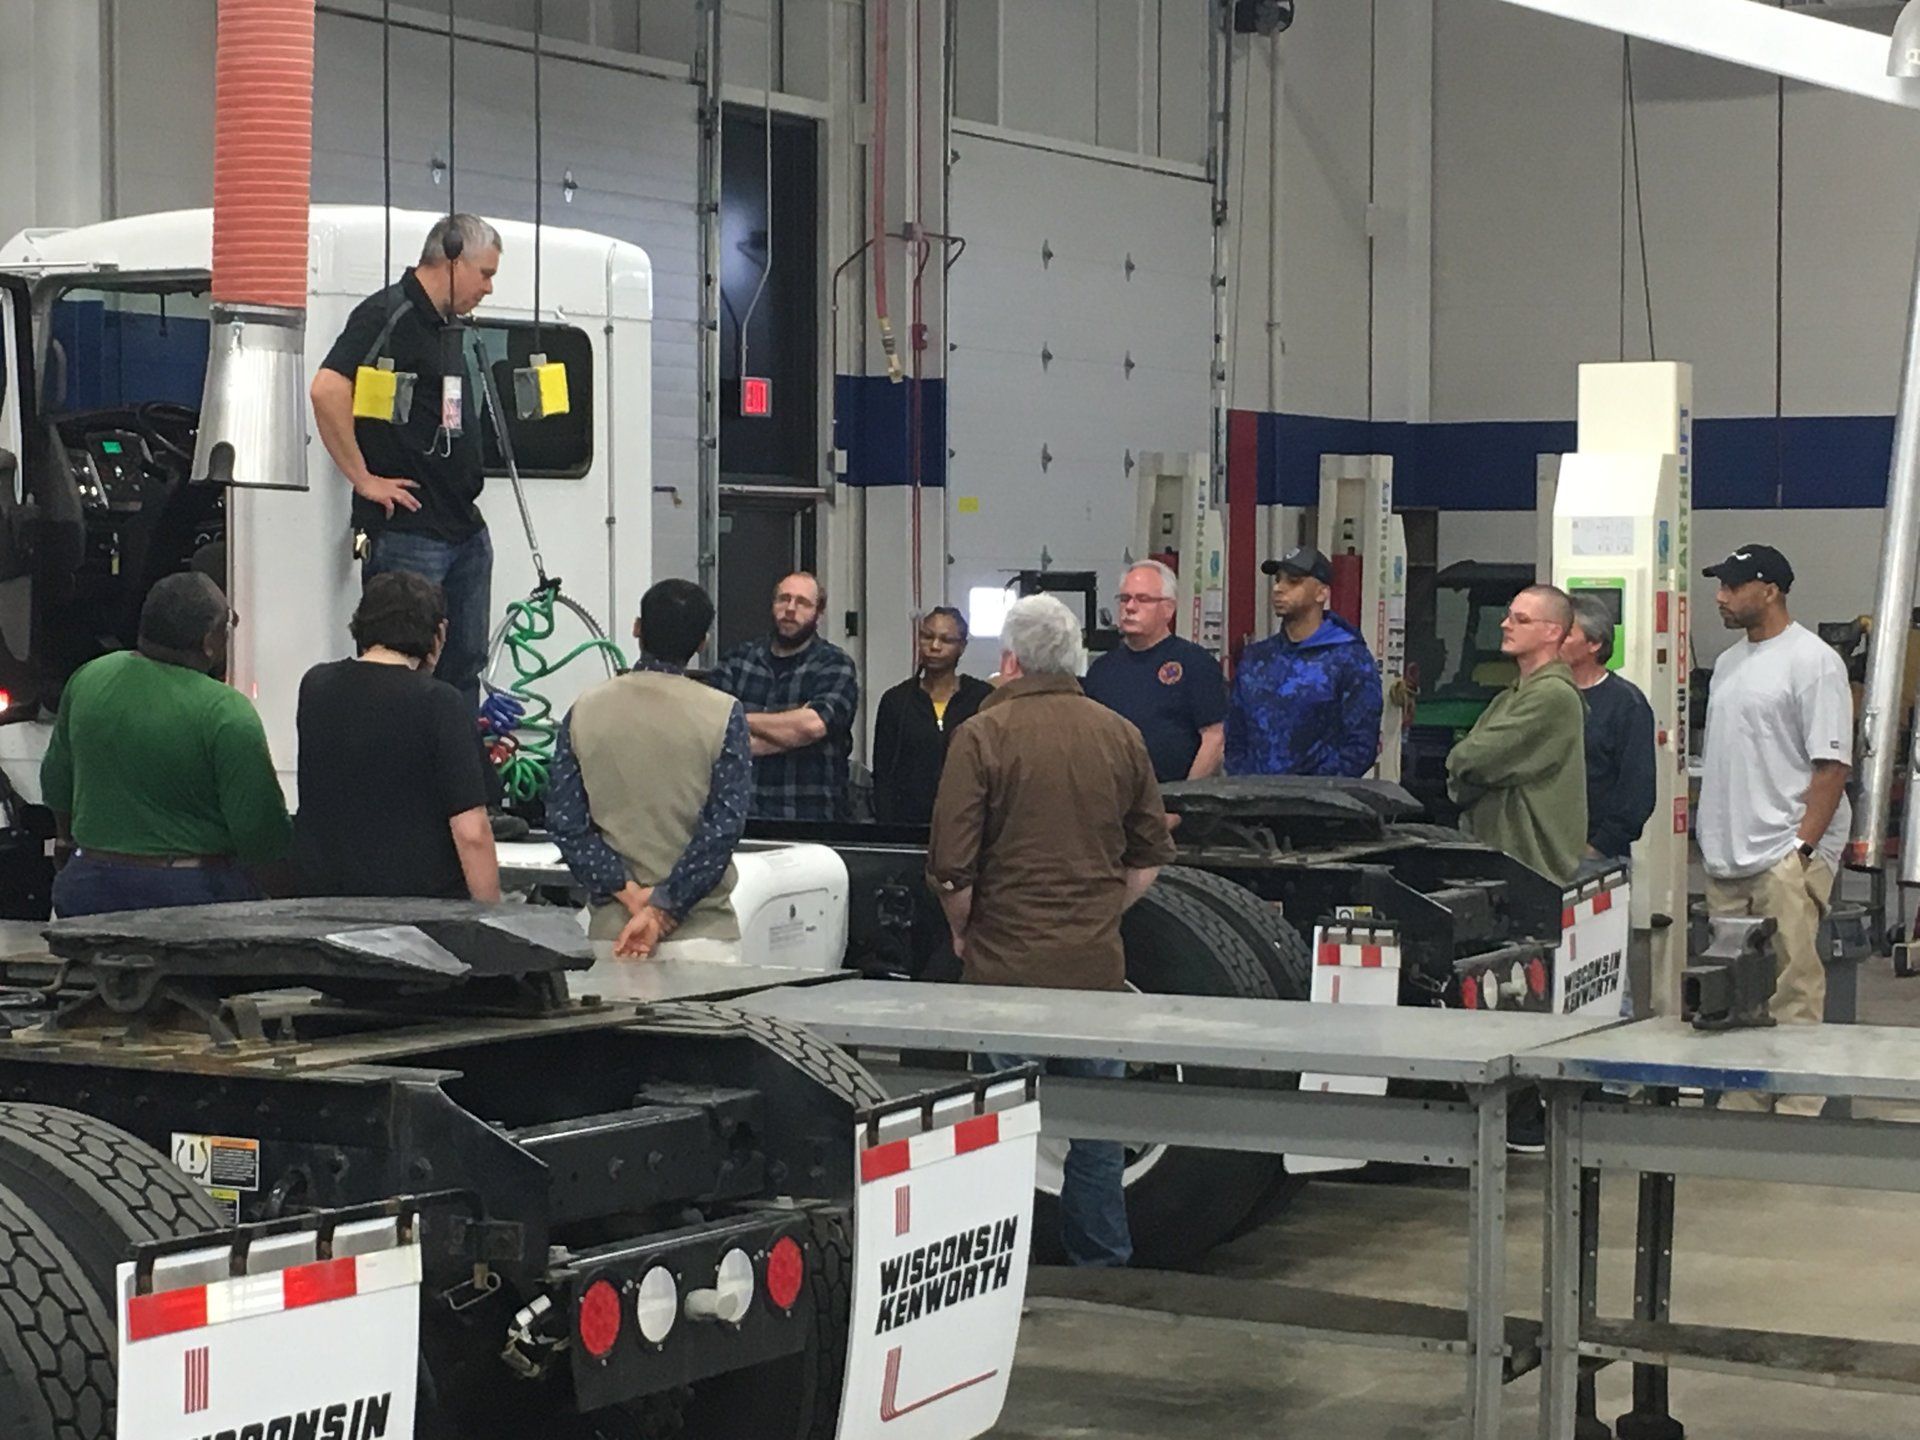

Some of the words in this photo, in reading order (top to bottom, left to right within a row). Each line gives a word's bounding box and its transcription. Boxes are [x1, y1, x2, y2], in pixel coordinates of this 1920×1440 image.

[1678, 403, 1689, 592] EARTHLIFT
[1562, 971, 1620, 1014] KENWORTH
[1564, 948, 1622, 994] WISCONSIN
[880, 1214, 1018, 1296] WISCONSIN
[875, 1252, 1012, 1336] KENWORTH
[191, 1392, 392, 1440] ONSIN
